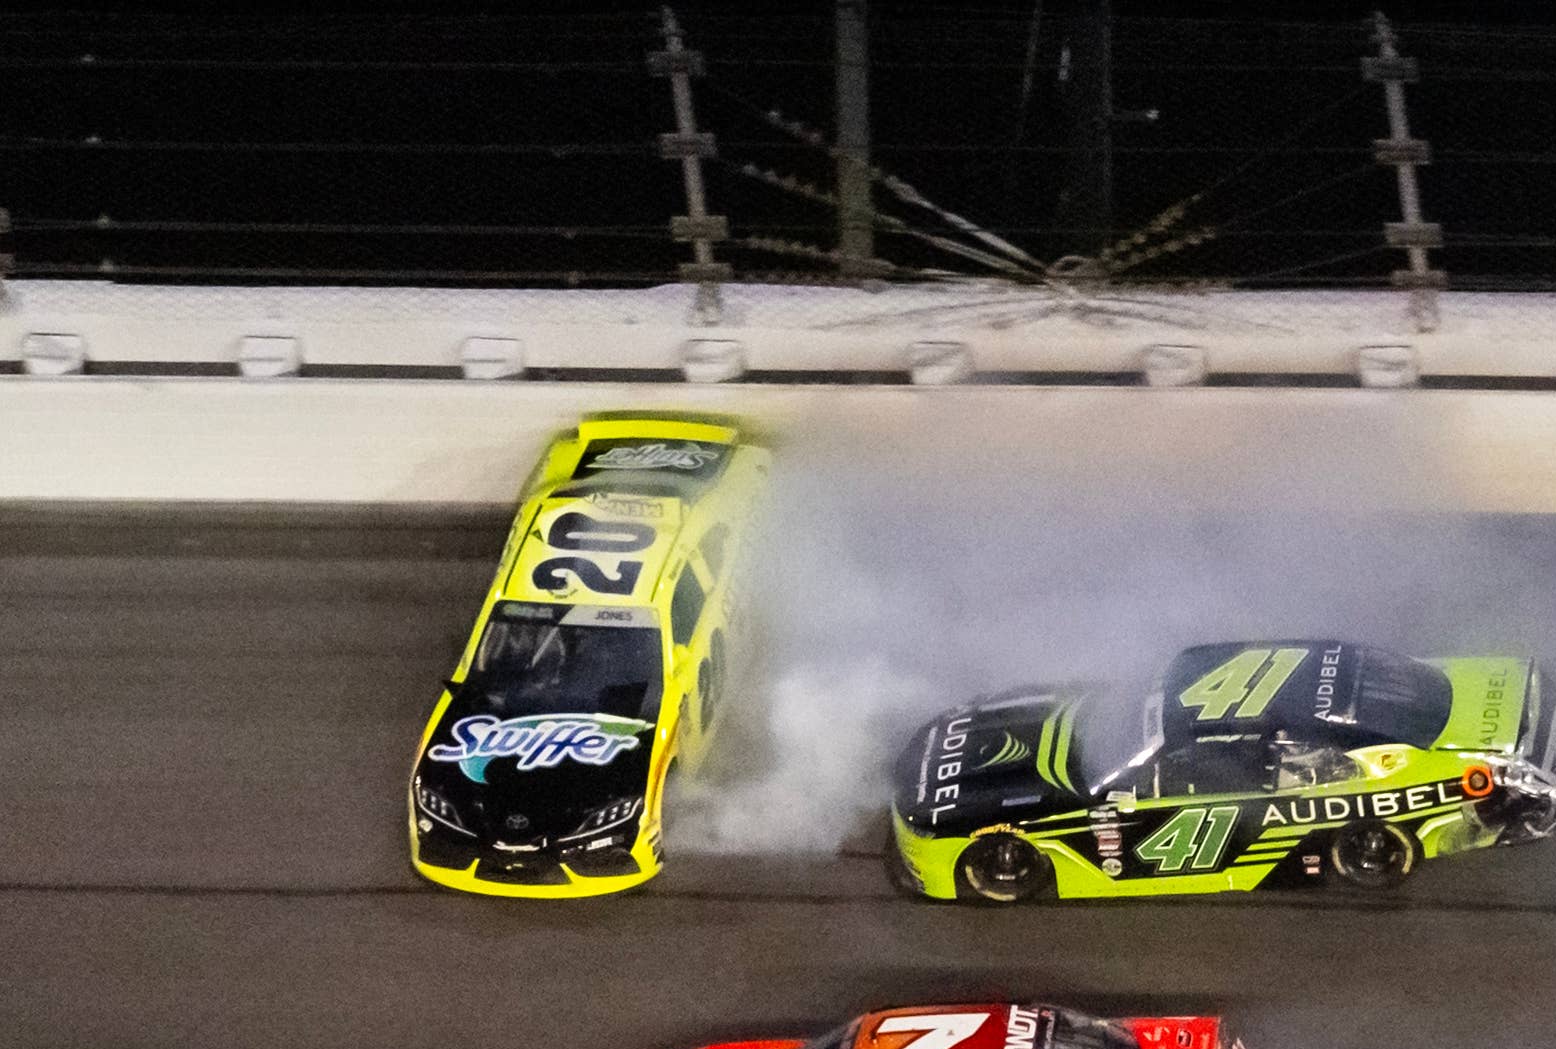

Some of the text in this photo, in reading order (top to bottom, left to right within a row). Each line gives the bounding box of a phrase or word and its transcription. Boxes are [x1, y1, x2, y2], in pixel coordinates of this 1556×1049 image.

[532, 512, 656, 595] 20
[595, 610, 633, 622] JONES
[1179, 648, 1309, 720] 41
[1314, 645, 1342, 722] AUDIBEL
[1479, 668, 1508, 746] AUDIBEL
[428, 714, 640, 772] Swiffer
[1136, 805, 1240, 872] 41
[1262, 783, 1463, 826] AUDIBEL
